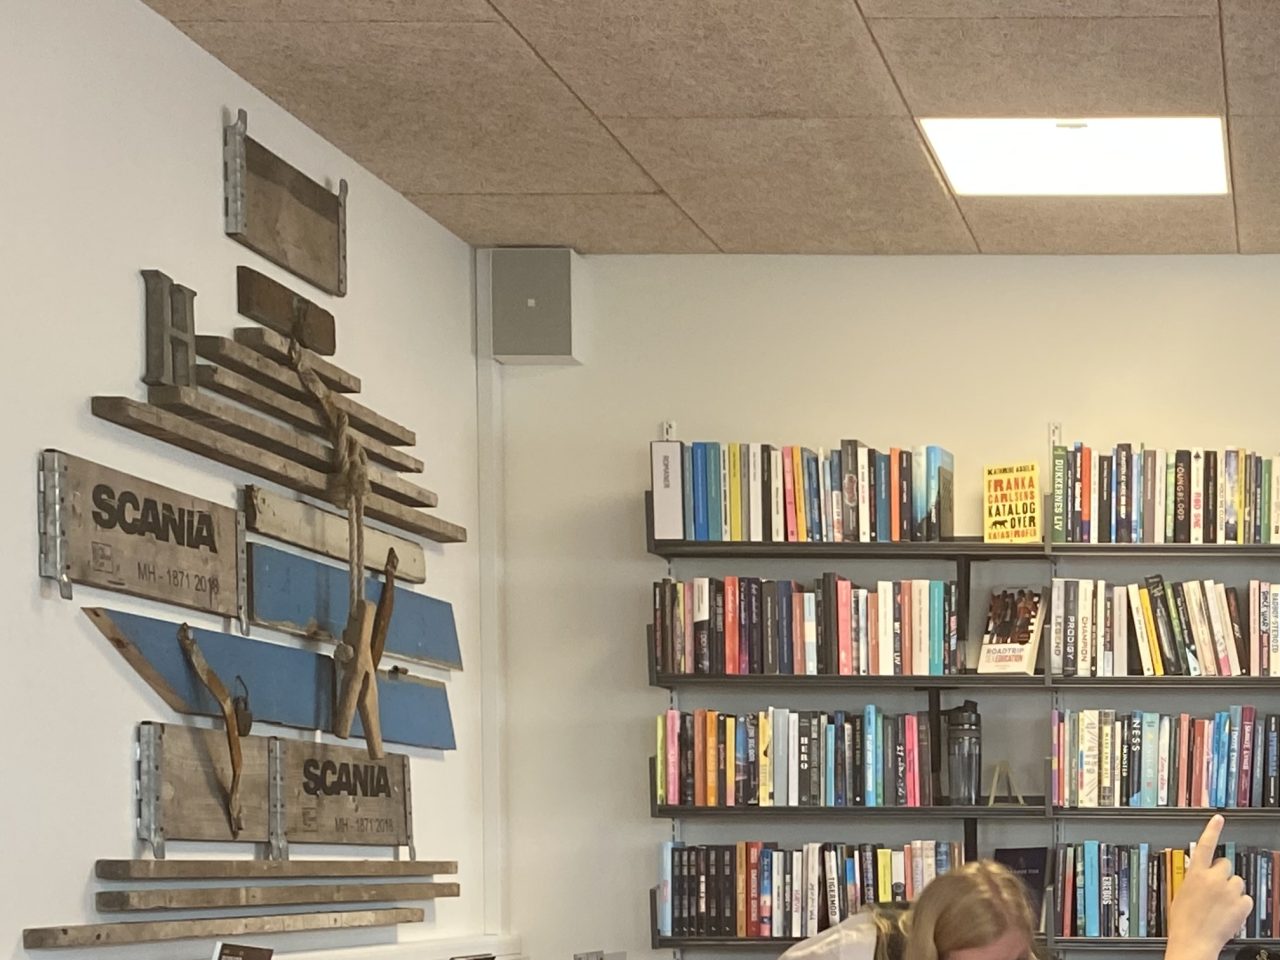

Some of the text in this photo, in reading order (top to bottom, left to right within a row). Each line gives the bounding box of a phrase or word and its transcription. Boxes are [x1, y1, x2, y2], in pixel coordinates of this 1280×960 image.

[663, 455, 671, 489] ROMANER
[988, 476, 1035, 493] FRANKA
[988, 491, 1034, 504] CARLSENS
[988, 502, 1035, 518] KATALOG
[1054, 459, 1063, 531] DUKKERNES LIV
[92, 484, 218, 554] SCANIA
[1010, 516, 1036, 529] OVER
[138, 562, 156, 581] MH
[167, 569, 191, 589] 1871
[1054, 615, 1062, 657] LEGEND
[1067, 616, 1075, 660] PRODIGY
[1081, 616, 1089, 662] CHAMPION
[1132, 719, 1141, 752] NESS
[303, 758, 392, 798] SCANIA
